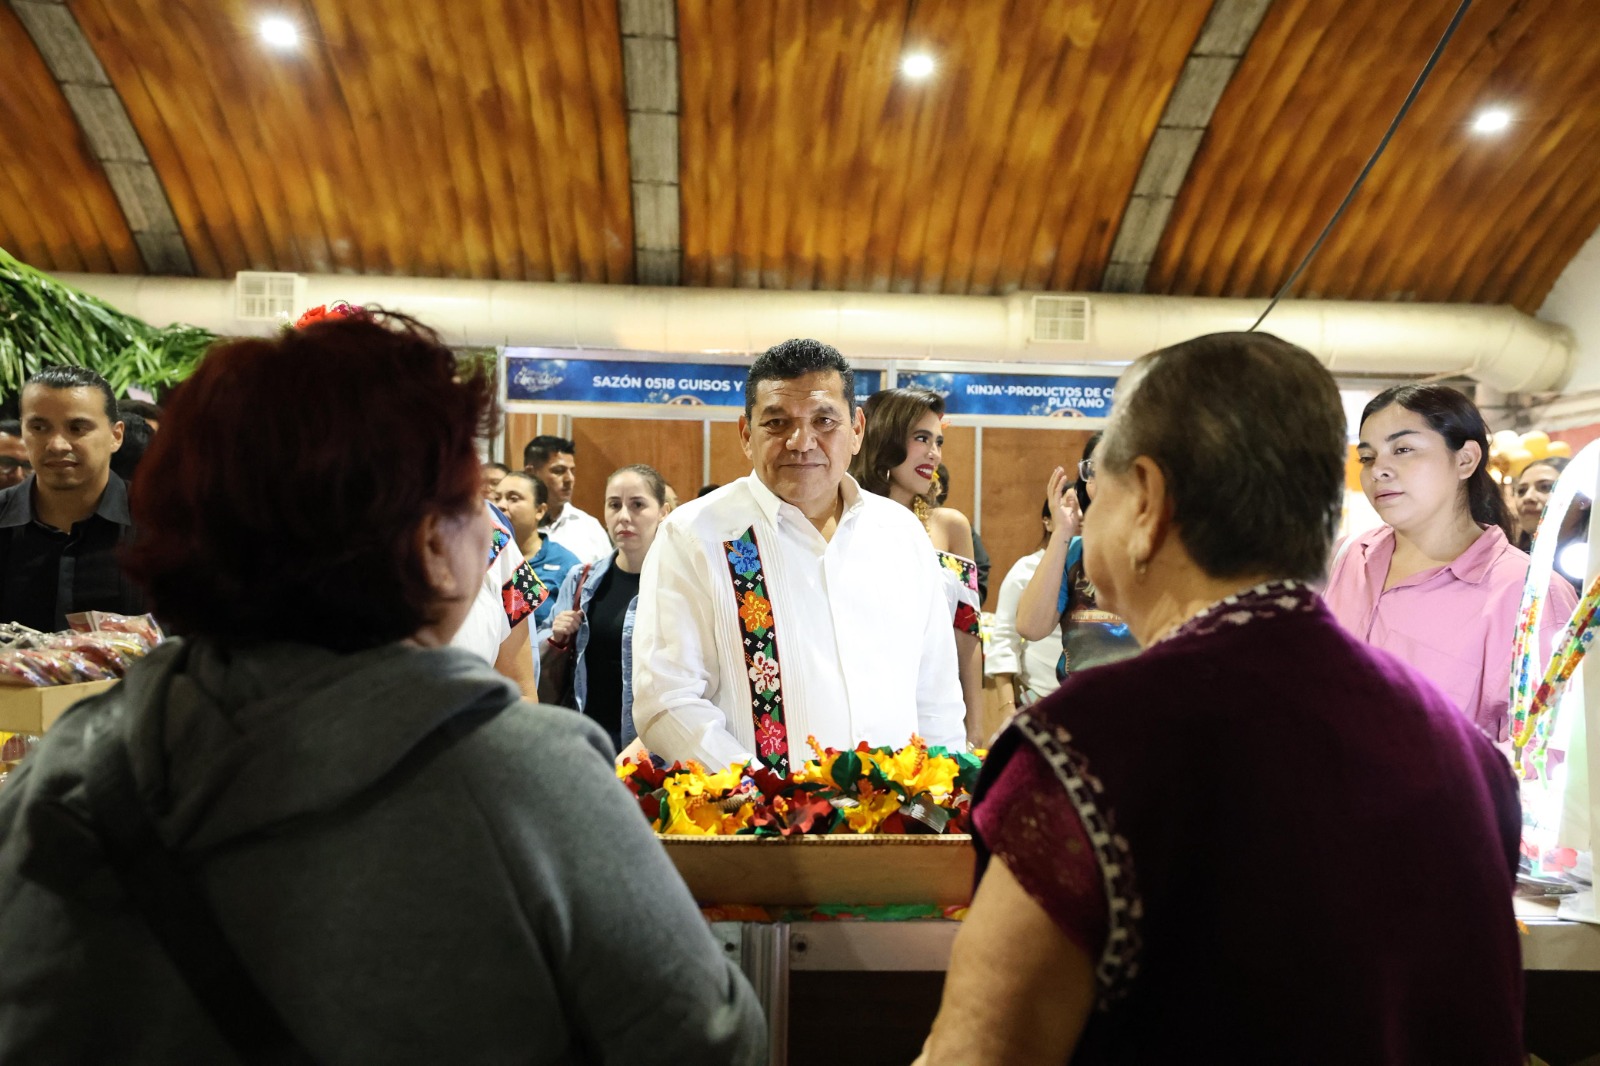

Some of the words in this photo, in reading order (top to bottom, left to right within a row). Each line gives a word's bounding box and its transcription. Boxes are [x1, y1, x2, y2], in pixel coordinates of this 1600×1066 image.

[593, 374, 641, 389] SAZÓN
[645, 377, 675, 389] 0518
[678, 379, 731, 391] GUISOS
[733, 381, 743, 392] Y
[1084, 387, 1101, 398] DE
